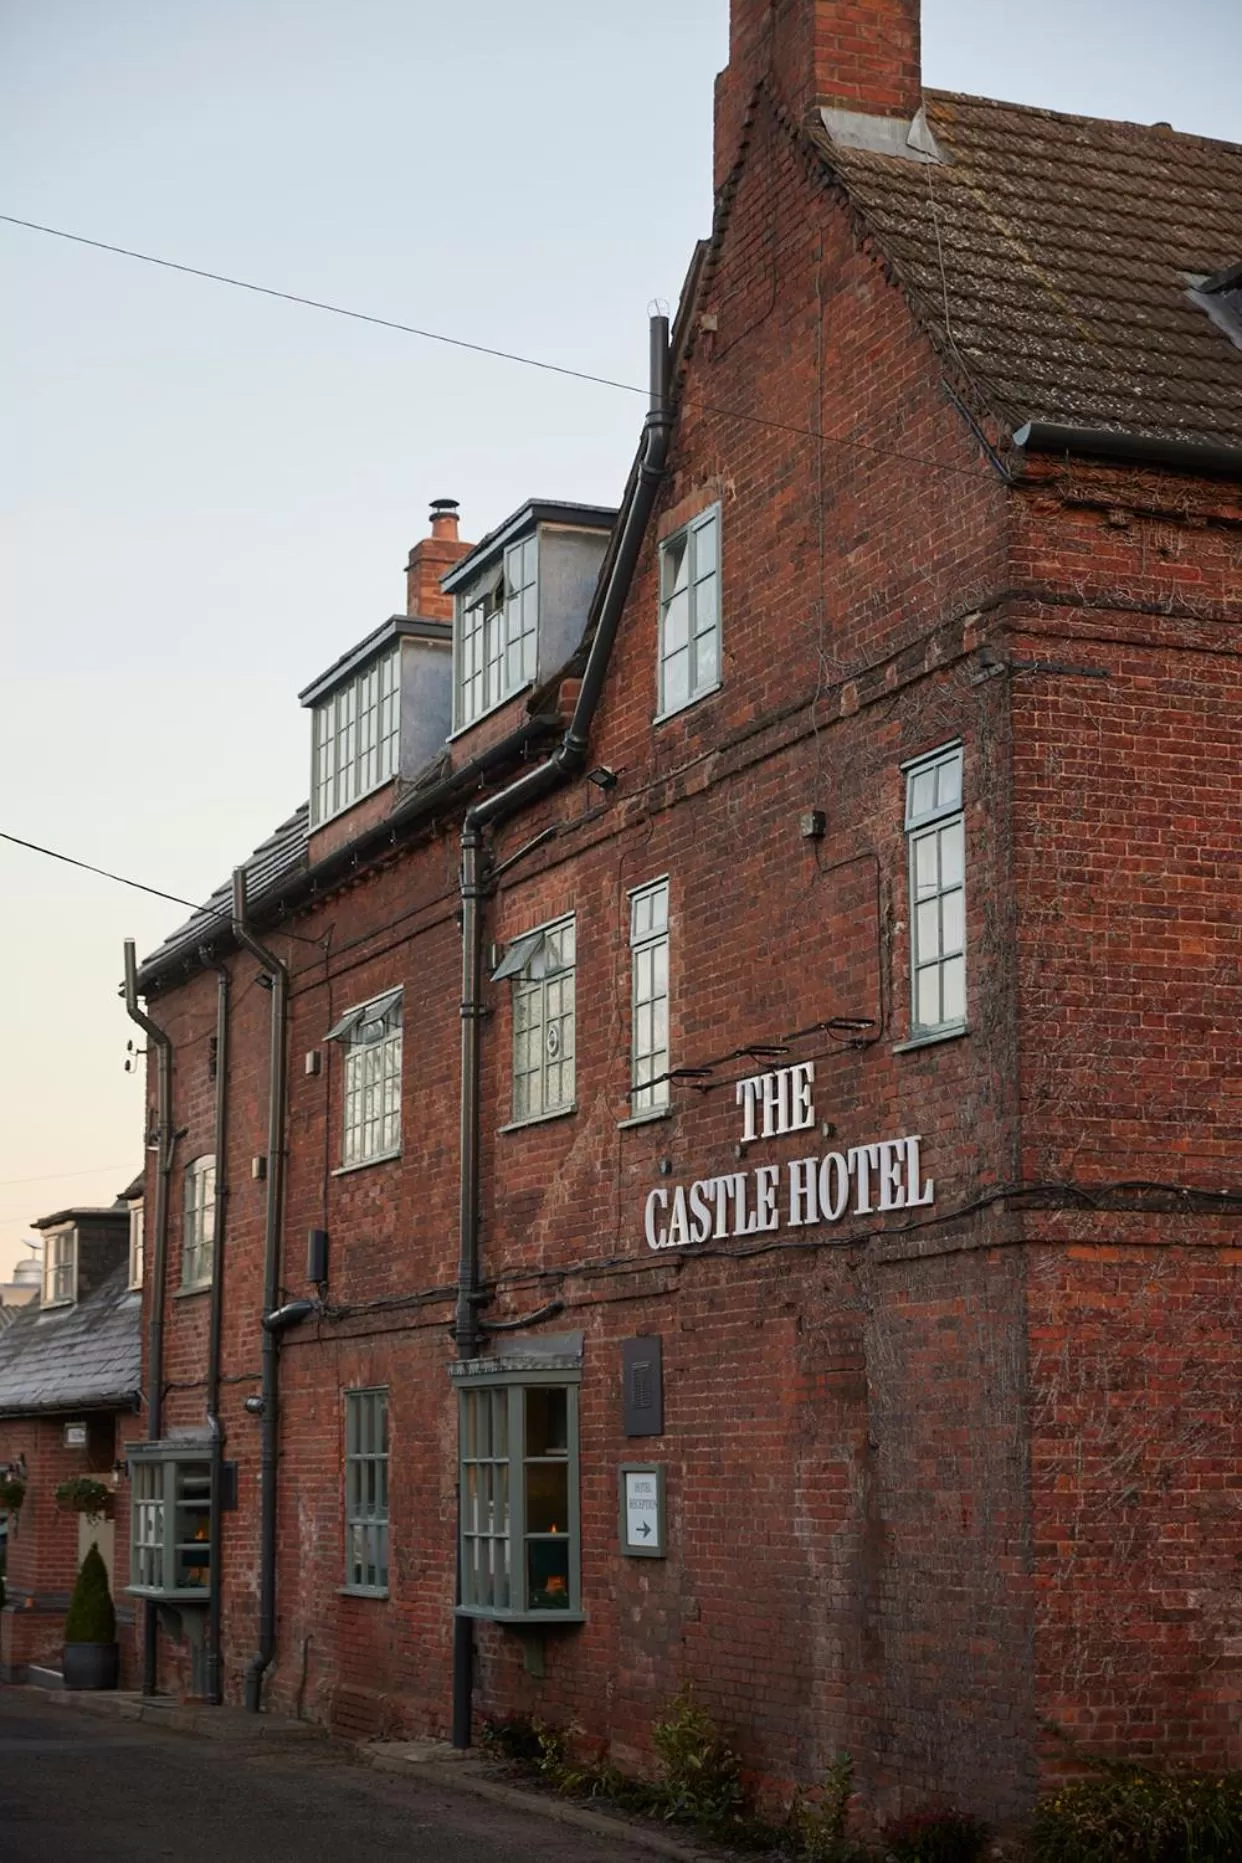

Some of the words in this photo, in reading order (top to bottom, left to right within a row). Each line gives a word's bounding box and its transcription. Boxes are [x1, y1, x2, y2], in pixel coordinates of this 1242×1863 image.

[736, 1061, 815, 1142] THE
[645, 1165, 780, 1250] CASTLE
[787, 1135, 933, 1226] HOTEL
